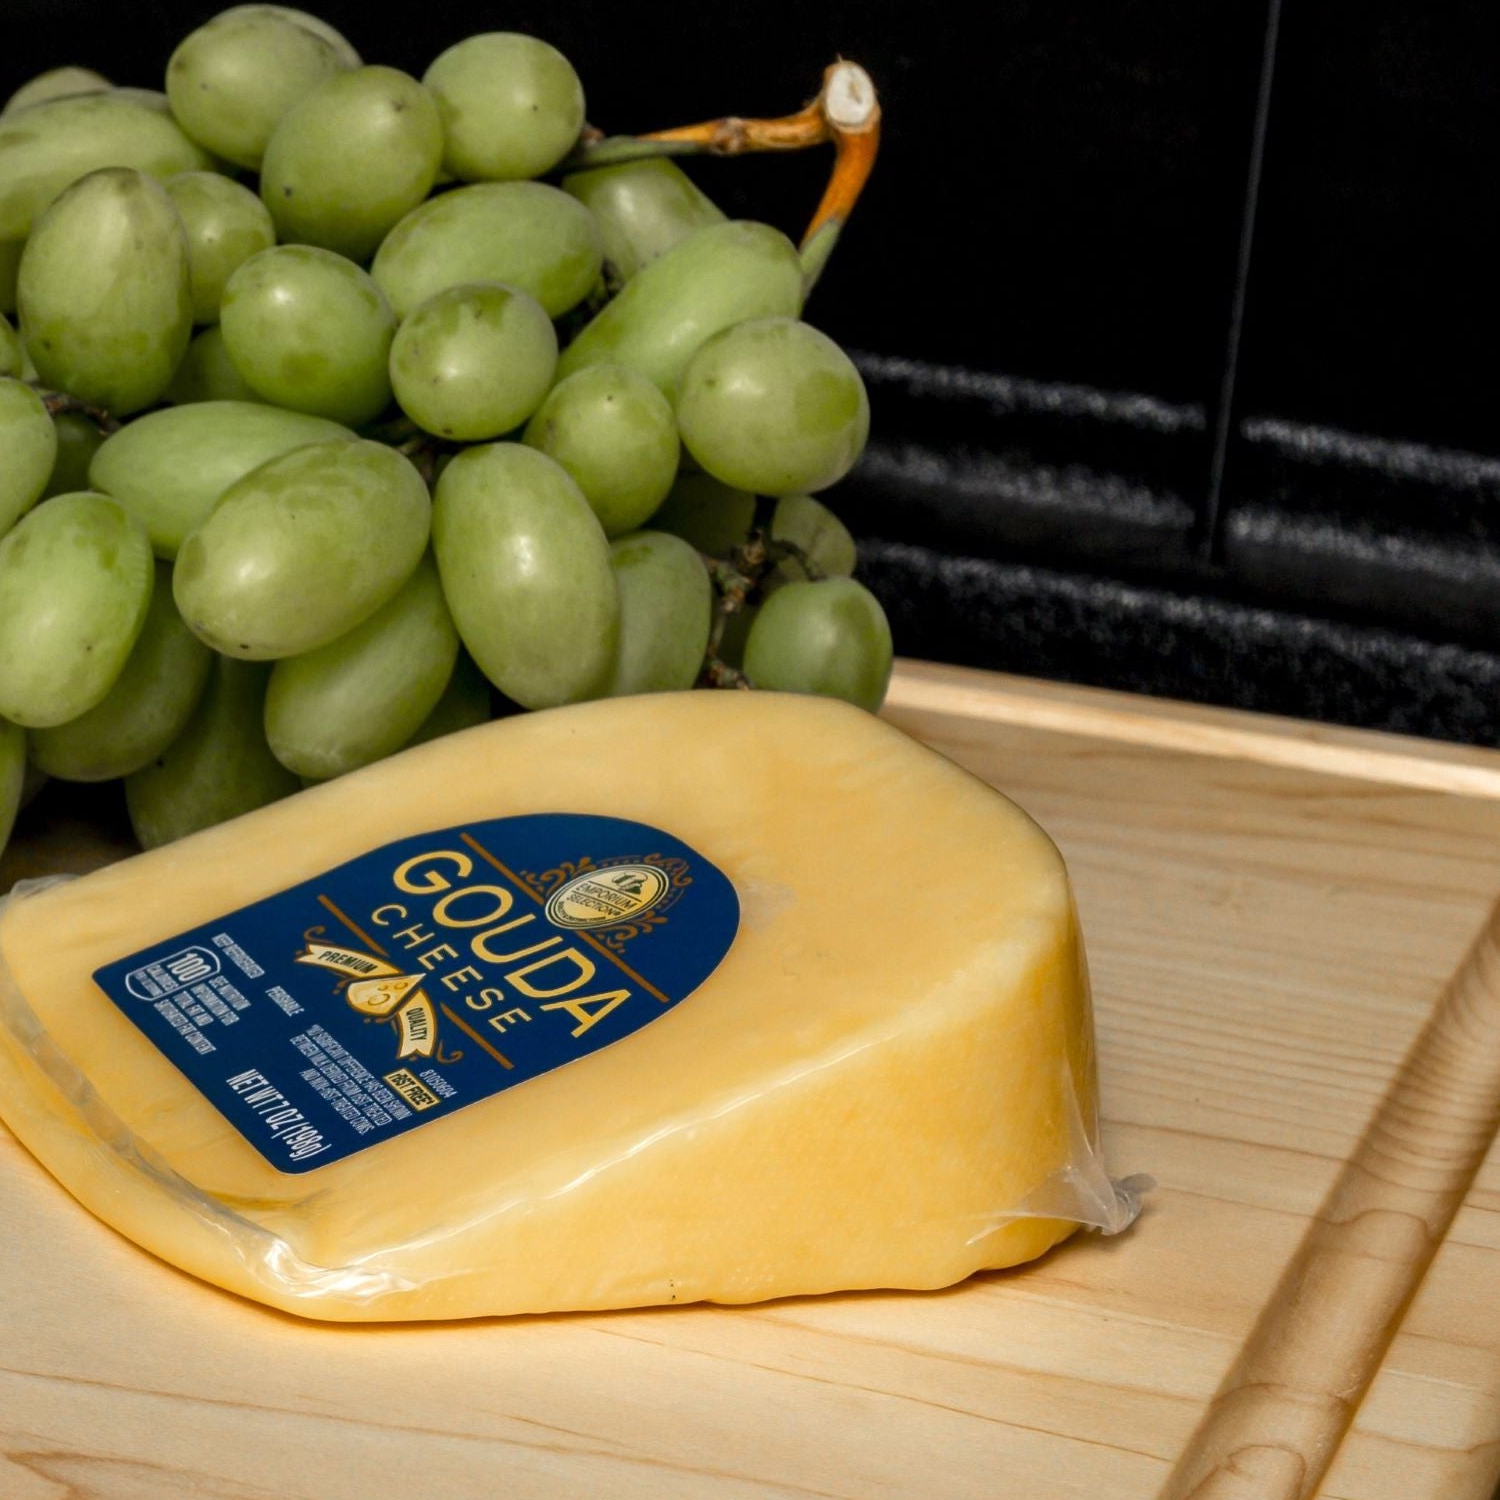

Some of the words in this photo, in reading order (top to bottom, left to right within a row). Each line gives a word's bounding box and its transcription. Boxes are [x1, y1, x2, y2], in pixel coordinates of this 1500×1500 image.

[576, 883, 637, 909] EMPORIUM
[393, 851, 631, 1037] GOUDA
[147, 965, 178, 991] CALORIES
[167, 954, 211, 981] 100
[372, 905, 531, 1032] CHEESE
[266, 986, 304, 1016] PERISHABLE
[318, 951, 377, 973] PREMIUM
[406, 1008, 426, 1041] QUALITY
[290, 1034, 320, 1057] BETWEEN
[313, 1032, 349, 1059] SIGNIFICANT
[338, 1056, 374, 1084] DIFFERENCE
[226, 1069, 269, 1094] NET
[389, 1074, 416, 1089] rBST
[244, 1086, 284, 1108] WT
[259, 1101, 290, 1114] 7
[266, 1109, 304, 1130] OZ
[272, 1122, 331, 1161] (198g)
